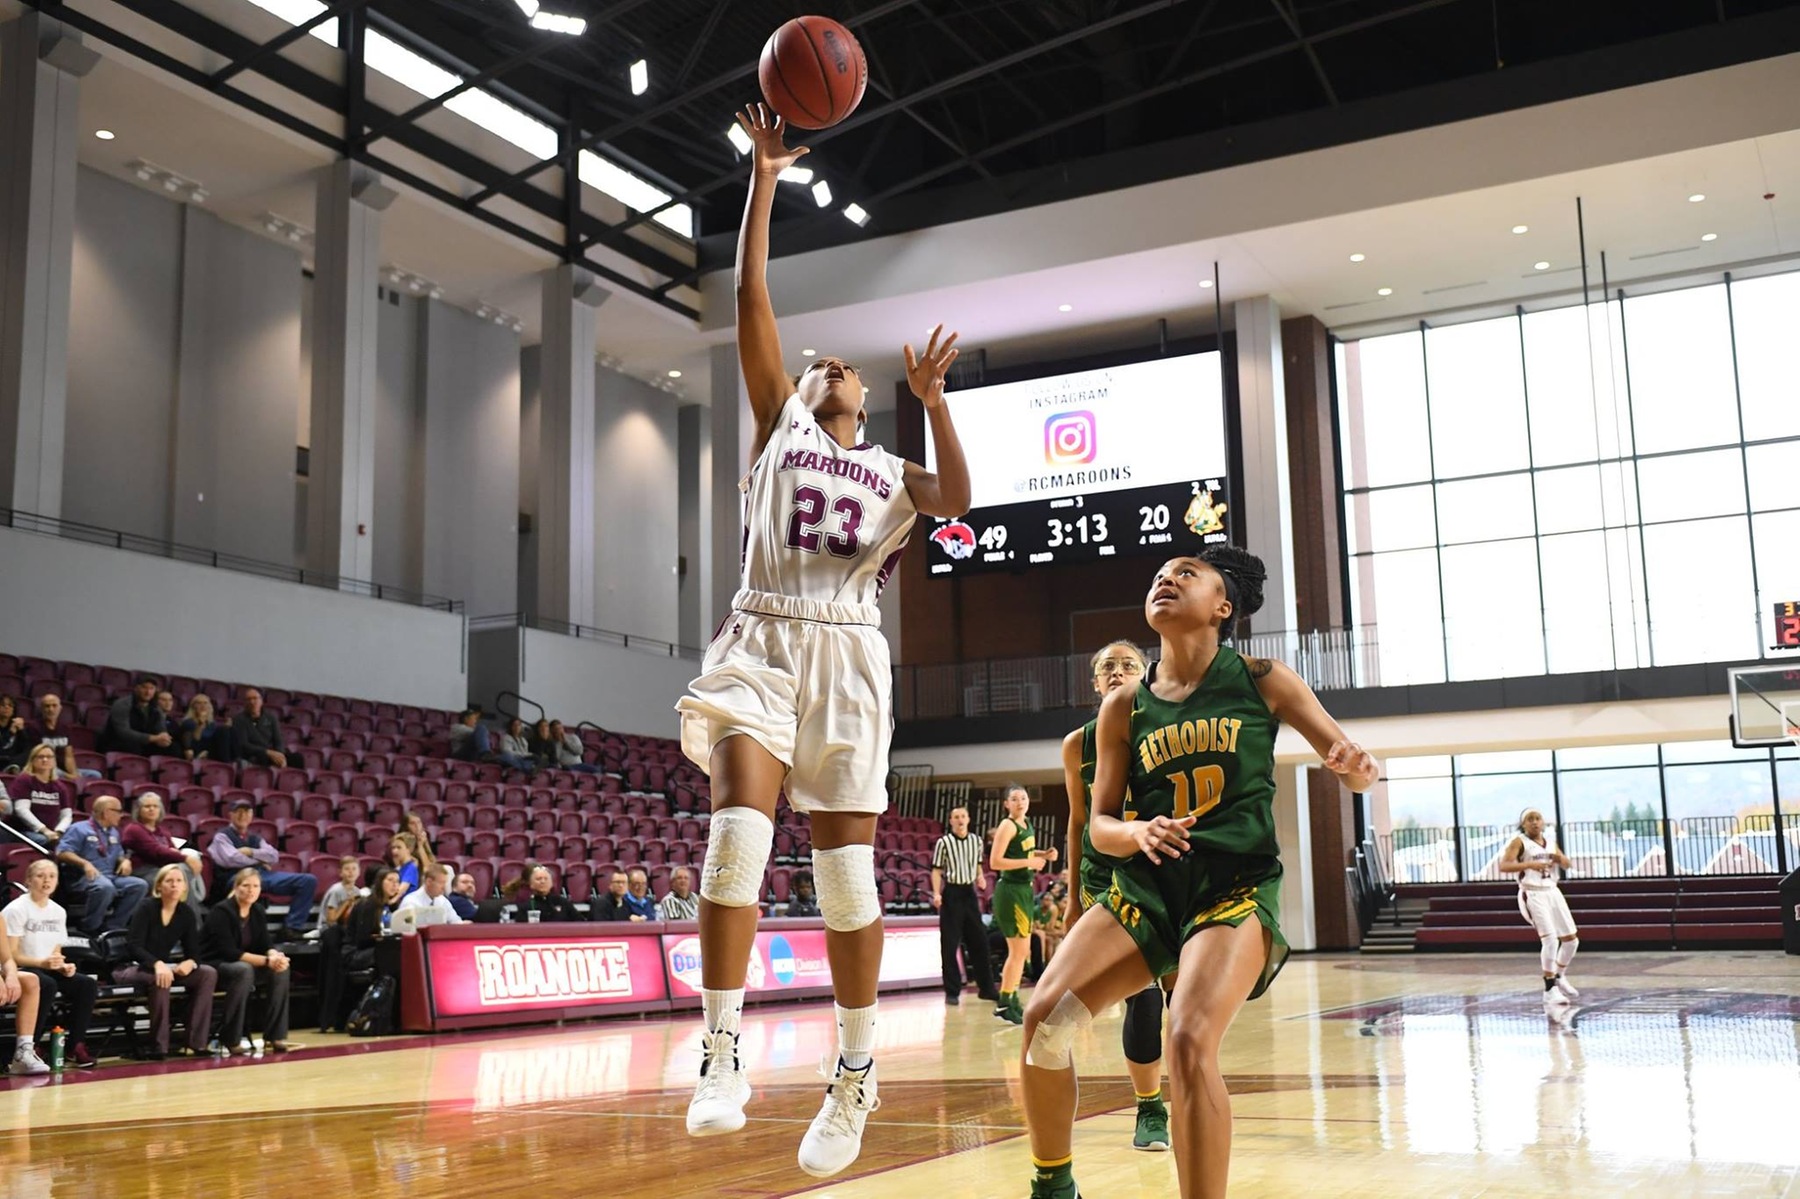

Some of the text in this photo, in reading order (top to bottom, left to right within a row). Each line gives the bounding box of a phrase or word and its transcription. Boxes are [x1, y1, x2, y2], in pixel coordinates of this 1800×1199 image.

[1029, 387, 1108, 409] INSTAGRAM
[779, 449, 893, 502] MAROONS
[784, 483, 865, 560] 23
[978, 525, 1007, 550] 49
[1047, 513, 1108, 548] 3:13
[1139, 504, 1170, 531] 20
[1165, 764, 1225, 819] 10
[477, 946, 630, 1000] ROANOKE
